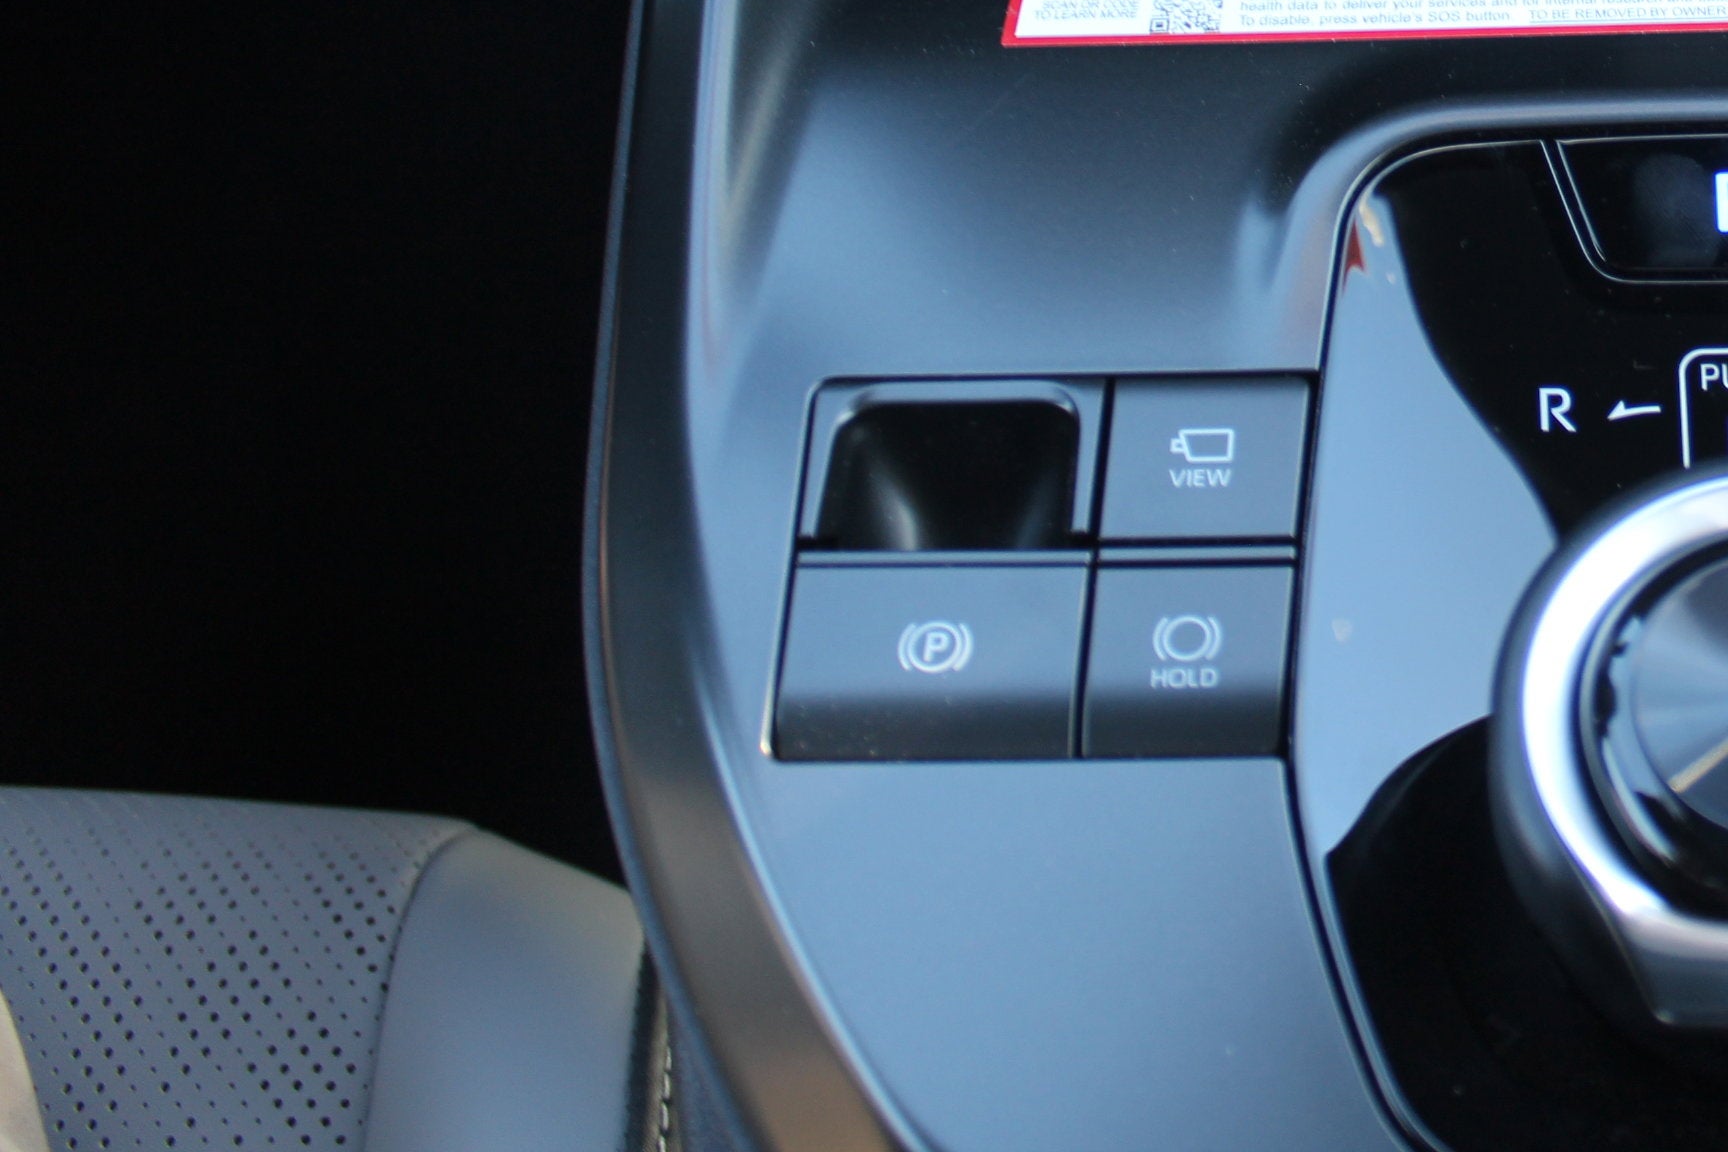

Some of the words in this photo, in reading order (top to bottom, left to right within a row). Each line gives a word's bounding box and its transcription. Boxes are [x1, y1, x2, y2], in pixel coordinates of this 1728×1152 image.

[1055, 9, 1096, 20] LEARN
[1101, 8, 1139, 19] MORE
[1240, 0, 1283, 11] health
[1289, 0, 1319, 10] data
[1324, 0, 1336, 9] to
[1393, 0, 1423, 11] your
[1240, 14, 1255, 26] To
[1319, 14, 1357, 27] press
[1428, 10, 1461, 22] SOS
[1529, 9, 1548, 20] TO
[1552, 8, 1570, 19] BE
[1575, 5, 1646, 19] REMOVED
[1650, 6, 1667, 17] BY
[1672, 5, 1726, 17] OWNER
[1538, 387, 1577, 433] R
[1169, 468, 1232, 488] VIEW
[1150, 668, 1218, 689] HOLD
